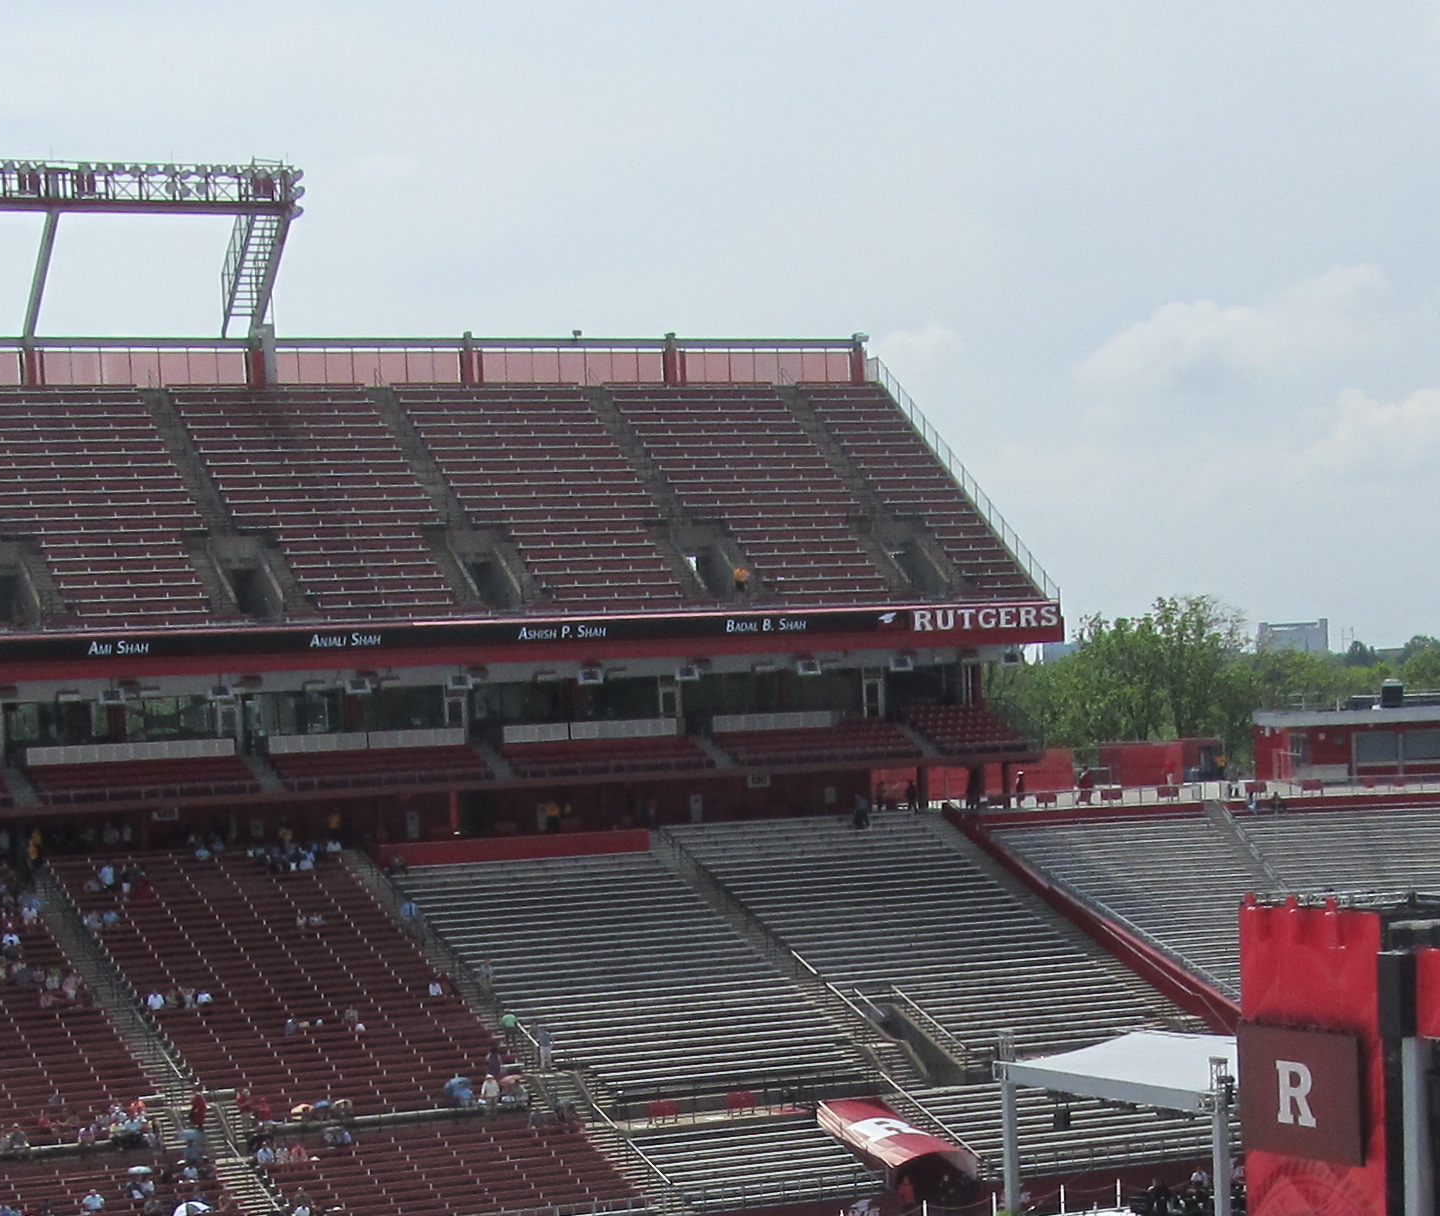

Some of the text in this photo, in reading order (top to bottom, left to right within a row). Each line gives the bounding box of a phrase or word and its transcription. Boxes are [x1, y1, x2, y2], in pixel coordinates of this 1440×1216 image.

[778, 617, 807, 631] SHAH
[913, 606, 1058, 631] RUTGERS
[561, 625, 572, 639] P.
[577, 624, 607, 638] SHAH
[350, 632, 382, 646] SHAH
[116, 640, 150, 654] SHAH
[1275, 1059, 1317, 1128] R
